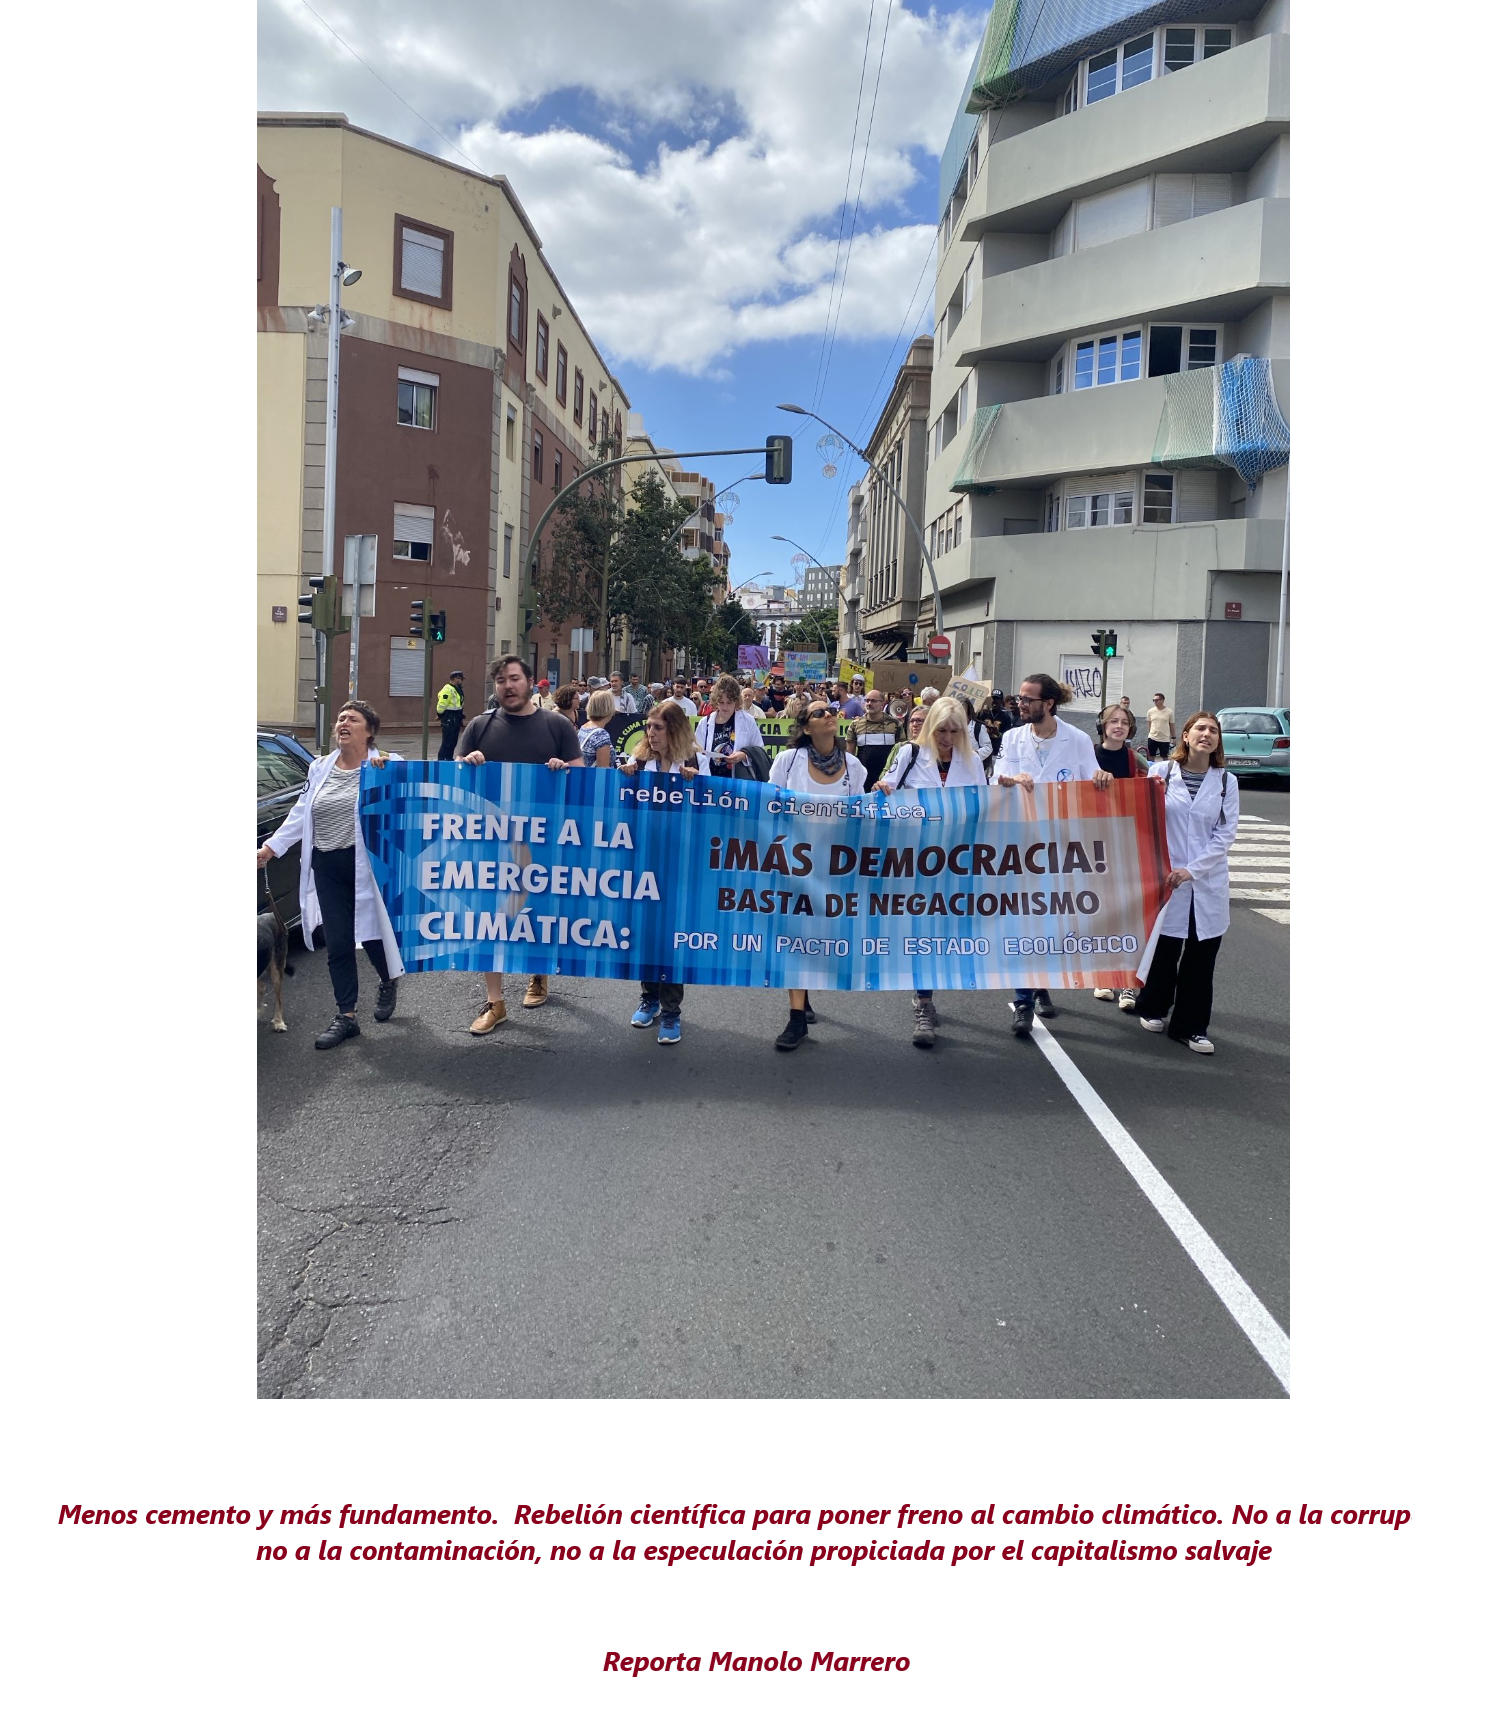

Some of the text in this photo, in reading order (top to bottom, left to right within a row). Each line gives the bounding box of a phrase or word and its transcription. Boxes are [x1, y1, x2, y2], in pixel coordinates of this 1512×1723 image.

[622, 721, 641, 736] CLIMA
[619, 786, 942, 822] rebelión científica_
[422, 814, 634, 850] FRENTE A LA
[709, 834, 1107, 878] ¡MÁS DEMOCRACIA!
[421, 860, 661, 901] EMERGENCIA
[717, 887, 1100, 918] BASTA DE NEGACIONISMO
[419, 907, 631, 950] CLIMÁTICA:
[673, 931, 1138, 957] POR UN PACTO DE ESTADO ECOLÓGICO
